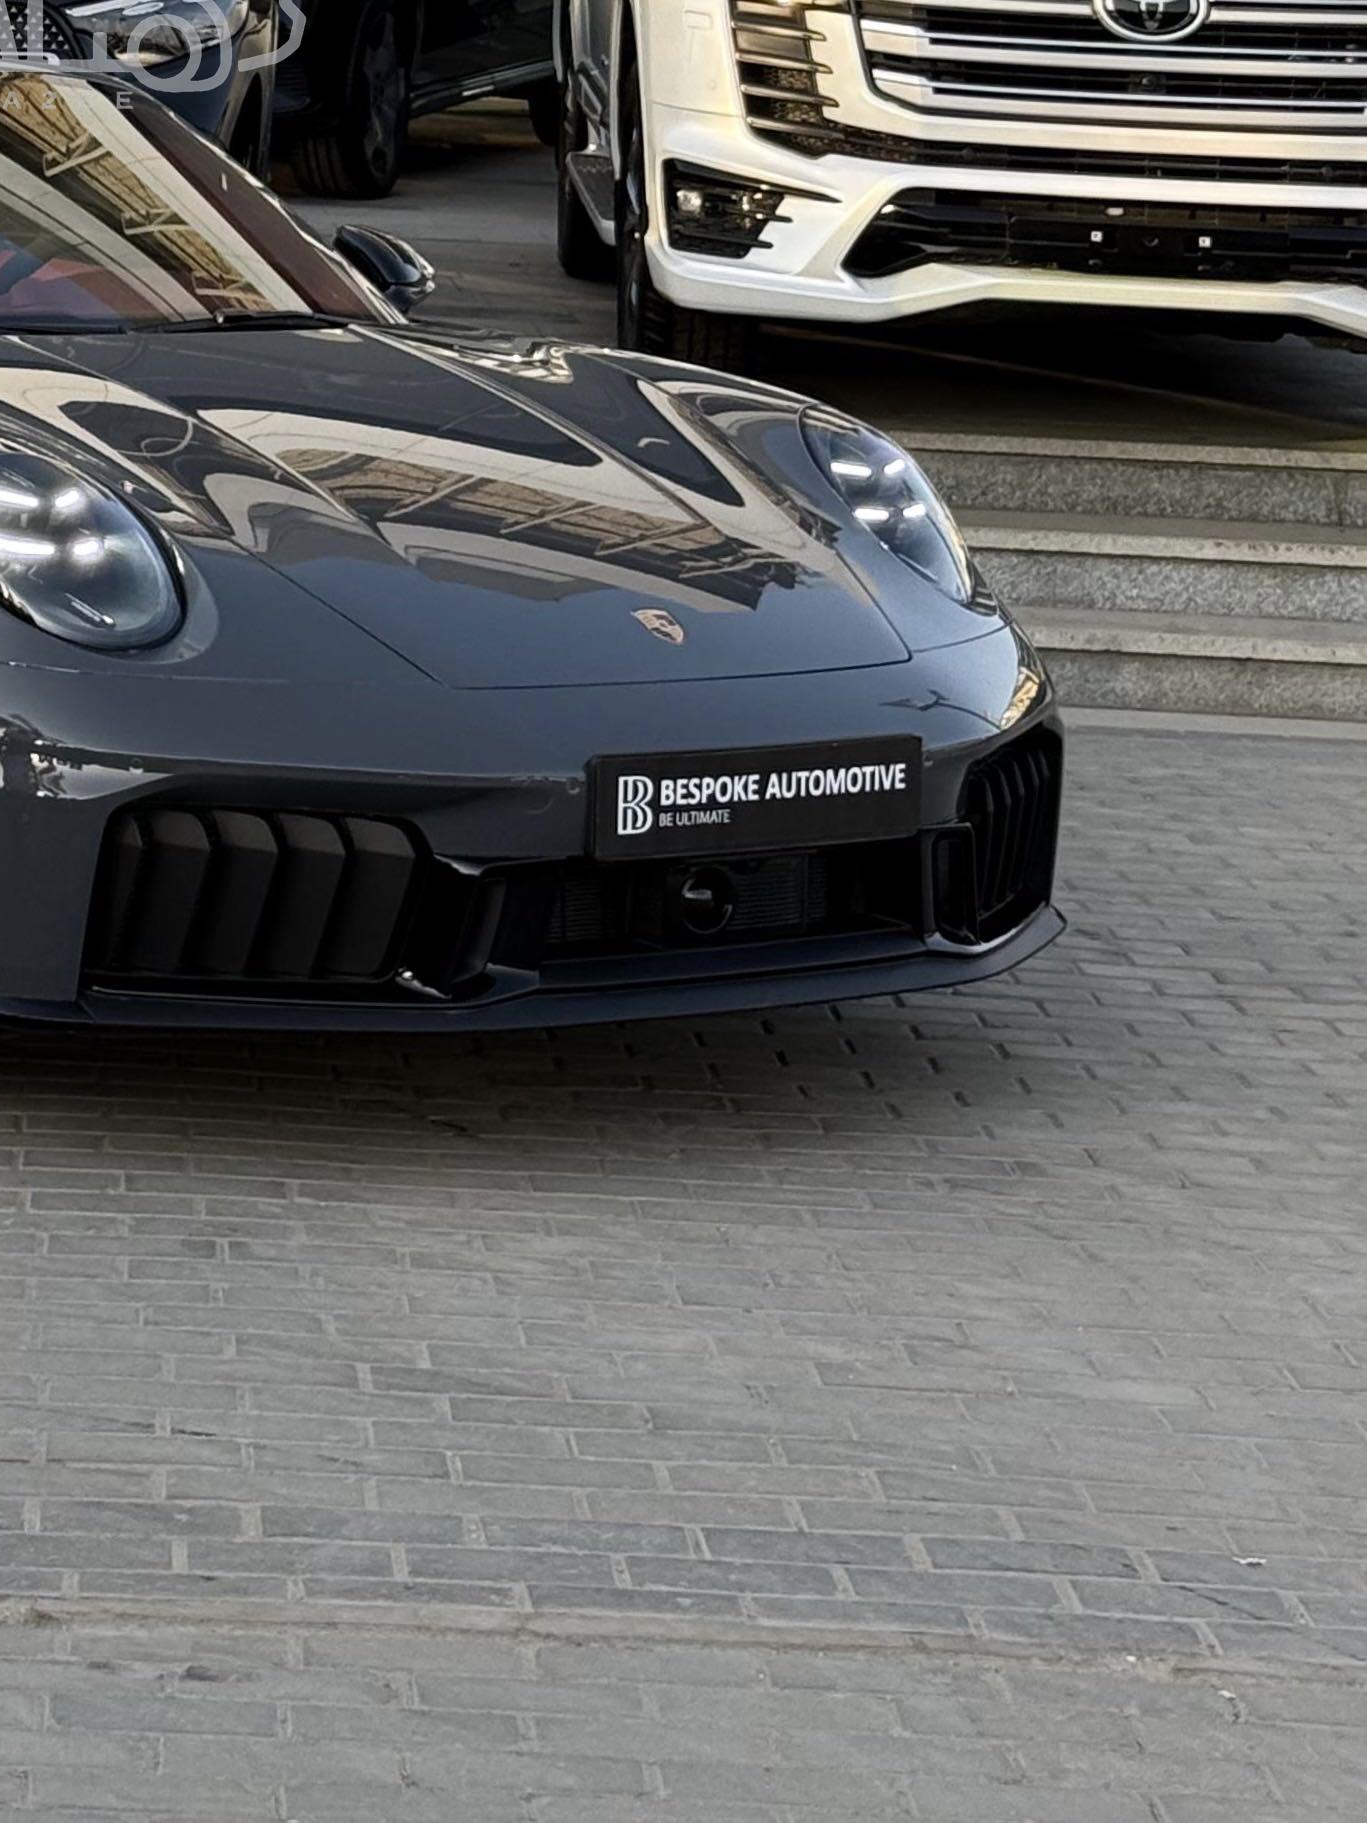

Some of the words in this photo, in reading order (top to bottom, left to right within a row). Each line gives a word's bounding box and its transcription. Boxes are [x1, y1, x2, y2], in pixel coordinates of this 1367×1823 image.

[659, 774, 761, 807] BESPOKE
[764, 762, 907, 802] AUTOMOTIVE
[658, 812, 674, 827] BE
[675, 809, 731, 826] ULTIMATE
